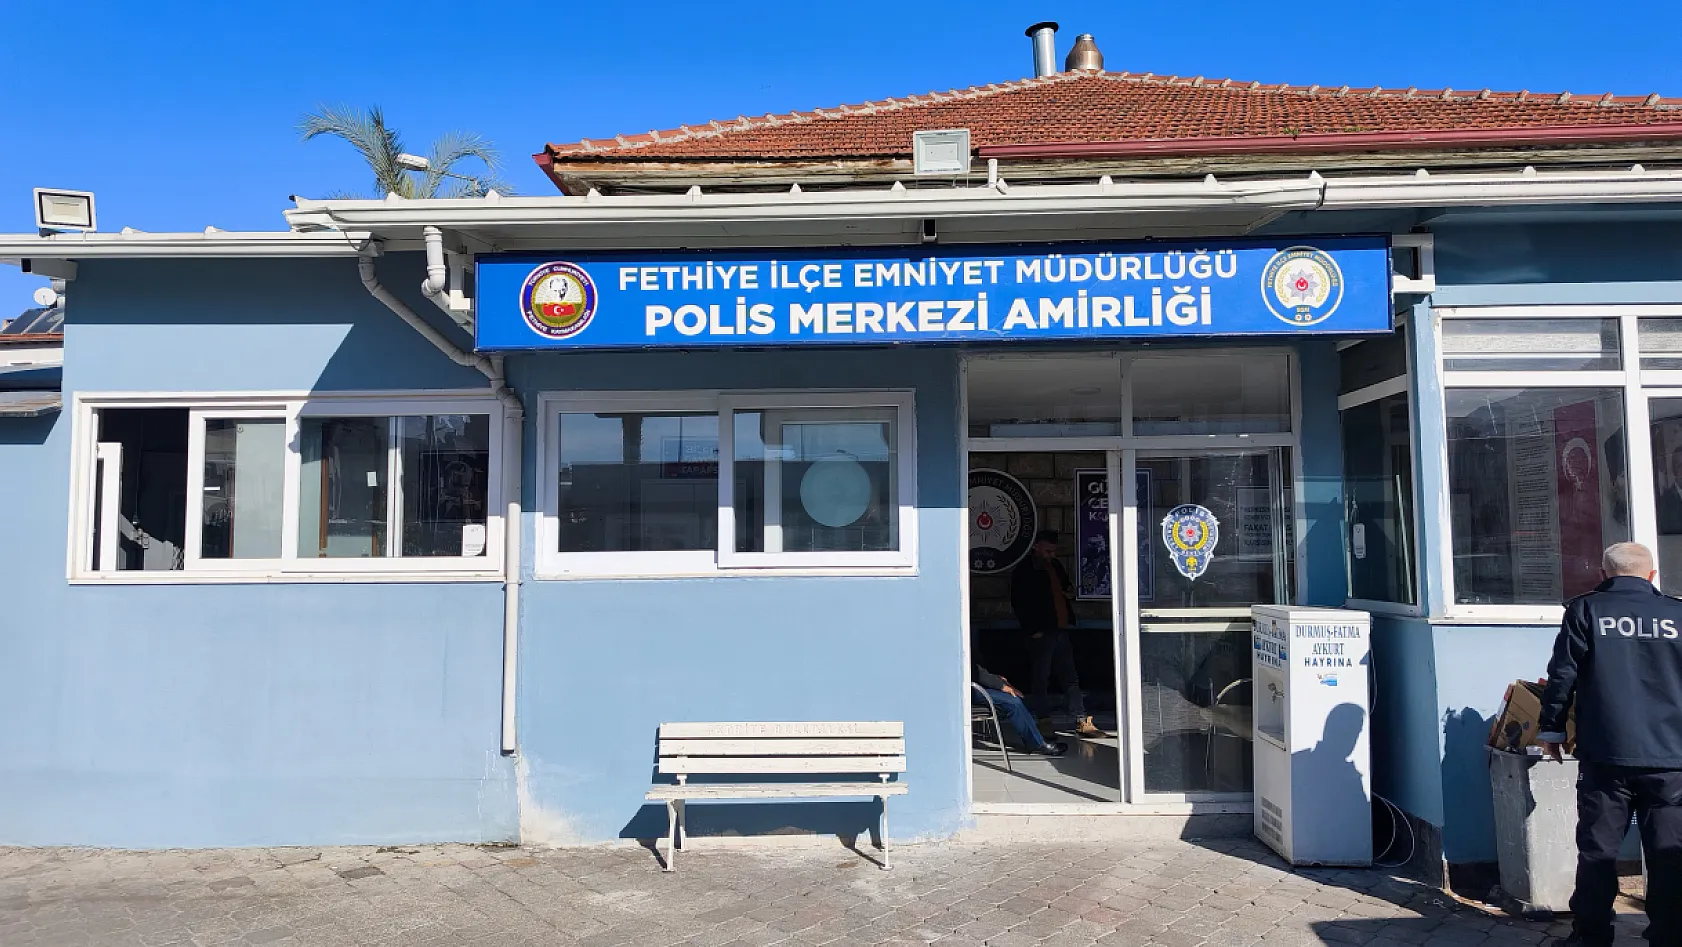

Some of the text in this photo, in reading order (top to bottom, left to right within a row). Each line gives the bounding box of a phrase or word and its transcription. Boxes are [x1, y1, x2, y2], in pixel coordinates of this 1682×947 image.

[620, 249, 1238, 292] FETHİYE İLÇE EMNİYET MÜDÜRLÜĞÜ
[645, 286, 1212, 336] POLİS MERKEZİ AMİRLİĞİ
[1174, 508, 1206, 519] POLİS
[1296, 625, 1361, 641] DURMUŞ-FATMA
[1599, 616, 1679, 639] POLİS
[1312, 643, 1345, 655] AYKURT
[1304, 657, 1353, 667] HAYRINA
